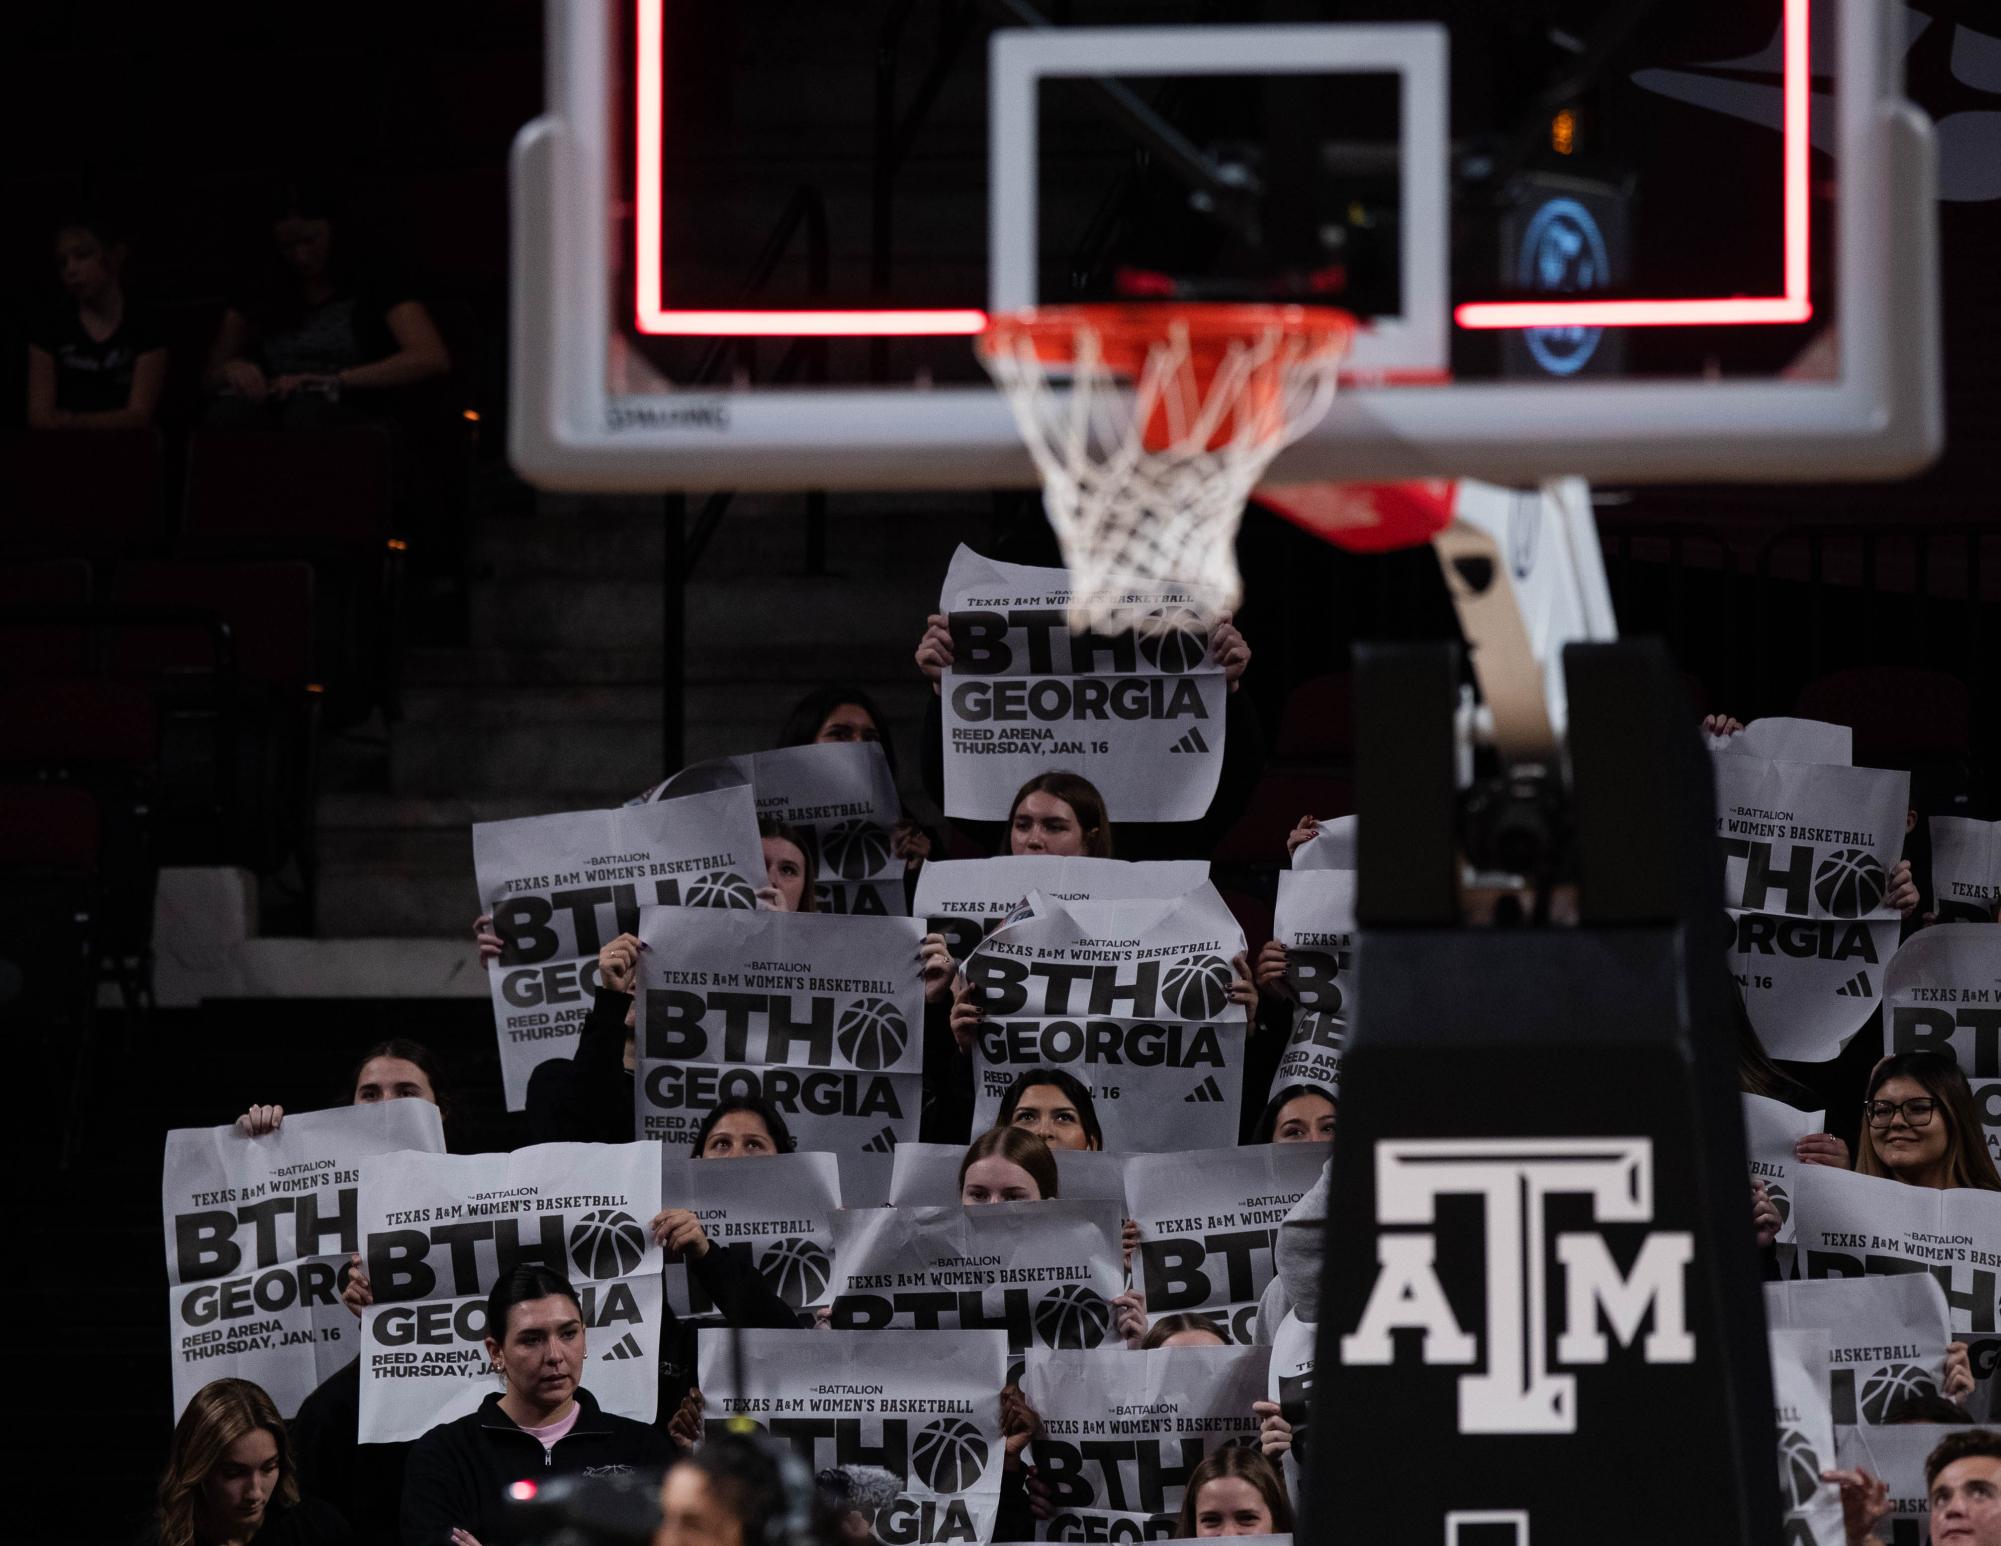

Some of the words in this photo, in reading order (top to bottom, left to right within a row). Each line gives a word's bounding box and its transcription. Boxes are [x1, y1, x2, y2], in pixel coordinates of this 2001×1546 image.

[967, 598, 1010, 607] TEXAS
[1012, 596, 1040, 606] A&M
[1119, 594, 1194, 604] ASKETBALL
[952, 679, 1209, 722] GEORGIA
[953, 728, 994, 740] REED
[998, 728, 1054, 740] ARENA
[953, 742, 1046, 757] THURSDAY,
[1049, 742, 1086, 754] JAN.
[1091, 742, 1109, 754] 16
[788, 801, 875, 821] BASKETBALL
[1737, 806, 1794, 821] BATTALION
[1728, 819, 1786, 838] WOMEN'S
[1790, 826, 1875, 847] BASKETBALL
[591, 852, 650, 866] BATTALION
[505, 876, 550, 893] TEXAS
[554, 872, 581, 885] A&M
[585, 865, 646, 883] WOMEN'S
[650, 853, 736, 876] BASKETBALL
[1952, 882, 1988, 899] TEXAS
[942, 902, 985, 913] TEXAS
[1080, 939, 1140, 948] BATTALION
[1294, 932, 1337, 946] TEXAS
[989, 940, 1033, 957] TEXAS
[1038, 947, 1065, 959] A&M
[1071, 948, 1132, 961] WOMEN'S
[1136, 941, 1221, 960] BASKETBALL
[752, 961, 812, 973] BATTALION
[663, 971, 707, 985] TEXAS
[712, 973, 739, 987] A&M
[744, 974, 804, 990] WOMEN'S
[809, 977, 895, 994] BASKETBALL
[1754, 975, 1772, 989] 16
[1911, 988, 1956, 1002] TEXAS
[1962, 988, 1989, 1003] A&M
[507, 1012, 549, 1030] REED
[977, 1020, 1225, 1068] GEORGIA
[984, 1070, 1013, 1083] REED
[645, 1065, 904, 1120] GEORGIA
[1102, 1087, 1120, 1099] 16
[645, 1116, 686, 1129] REED
[278, 1160, 336, 1177] BATTALION
[192, 1189, 237, 1207] TEXAS
[241, 1184, 266, 1200] A&M
[270, 1173, 330, 1194] WOMEN'S
[476, 1187, 538, 1201] BATTALION
[386, 1209, 430, 1226] TEXAS
[435, 1207, 462, 1220] A&M
[467, 1200, 532, 1217] WOMEN'S
[536, 1195, 628, 1212] BASKETBALL
[725, 1220, 815, 1237] BASKETBALL
[1156, 1218, 1203, 1234] TEXAS
[1208, 1214, 1236, 1229] A&M
[1821, 1232, 1867, 1248] TEXAS
[1871, 1236, 1899, 1251] A&M
[1904, 1242, 1966, 1261] WOMEN'S
[1912, 1232, 1973, 1246] BATTALION
[938, 1255, 1000, 1267] BATTALION
[847, 1274, 892, 1289] TEXAS
[897, 1272, 925, 1287] A&M
[930, 1270, 995, 1287] WOMEN'S
[1000, 1266, 1092, 1284] BASKETBALL
[182, 1329, 222, 1349] REED
[227, 1319, 284, 1340] ARENA
[182, 1336, 277, 1363] THURSDAY,
[280, 1331, 317, 1347] JAN.
[321, 1327, 341, 1341] 16
[372, 1350, 417, 1367] REED
[421, 1349, 482, 1364] ARENA
[1829, 1345, 1921, 1362] ASKETBALL
[372, 1363, 473, 1379] THURSDAY,
[819, 1385, 883, 1395] BATTALION
[723, 1399, 770, 1412] TEXAS
[775, 1399, 804, 1412] A&M
[810, 1399, 875, 1413] WOMEN'S
[880, 1398, 974, 1414] BASKETBALL
[1117, 1403, 1178, 1416] BATTALION
[1044, 1420, 1079, 1435] TEXAS
[1083, 1420, 1106, 1434] A&M
[1110, 1419, 1173, 1435] WOMEN'S
